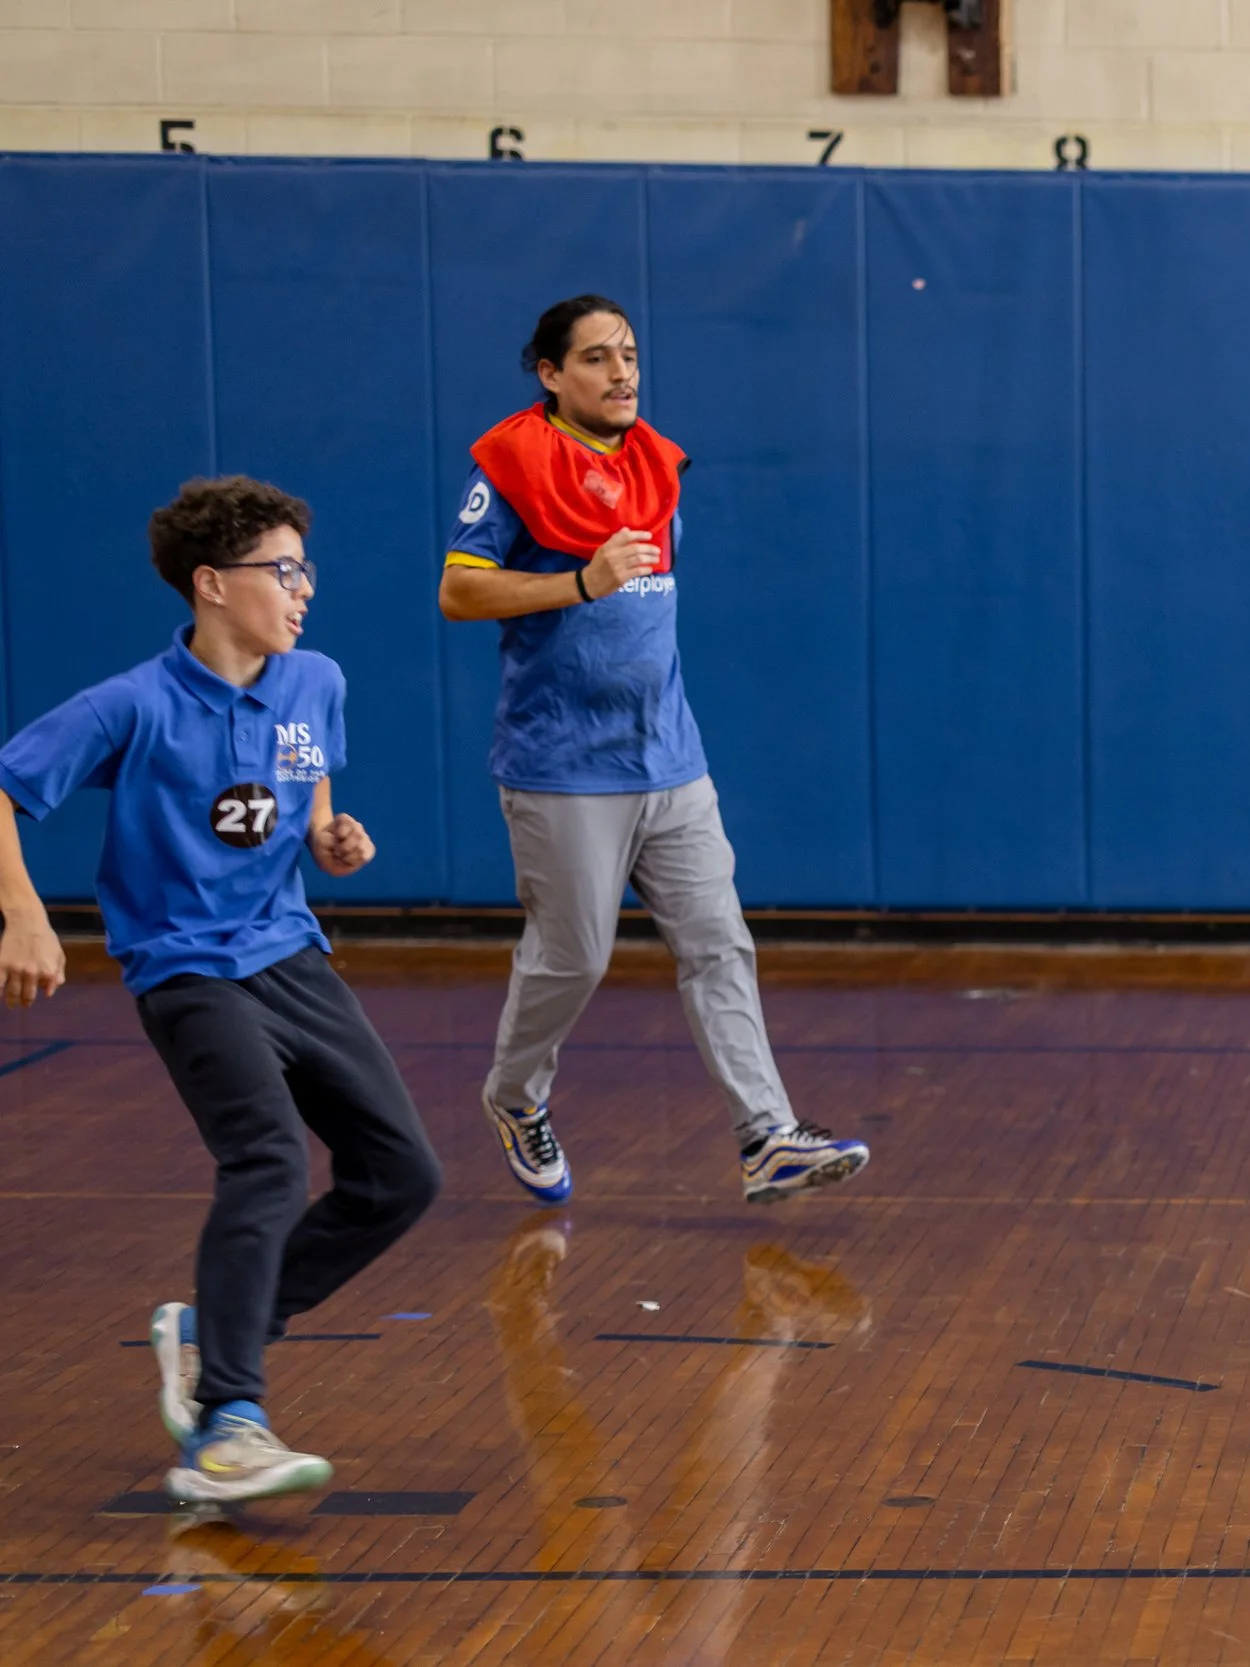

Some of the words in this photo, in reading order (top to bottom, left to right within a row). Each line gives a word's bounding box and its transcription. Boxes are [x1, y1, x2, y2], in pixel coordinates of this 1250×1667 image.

[159, 119, 196, 155] 5
[807, 130, 843, 167] 7
[274, 722, 311, 745] MS
[296, 745, 324, 768] 50
[215, 798, 275, 833] 27
